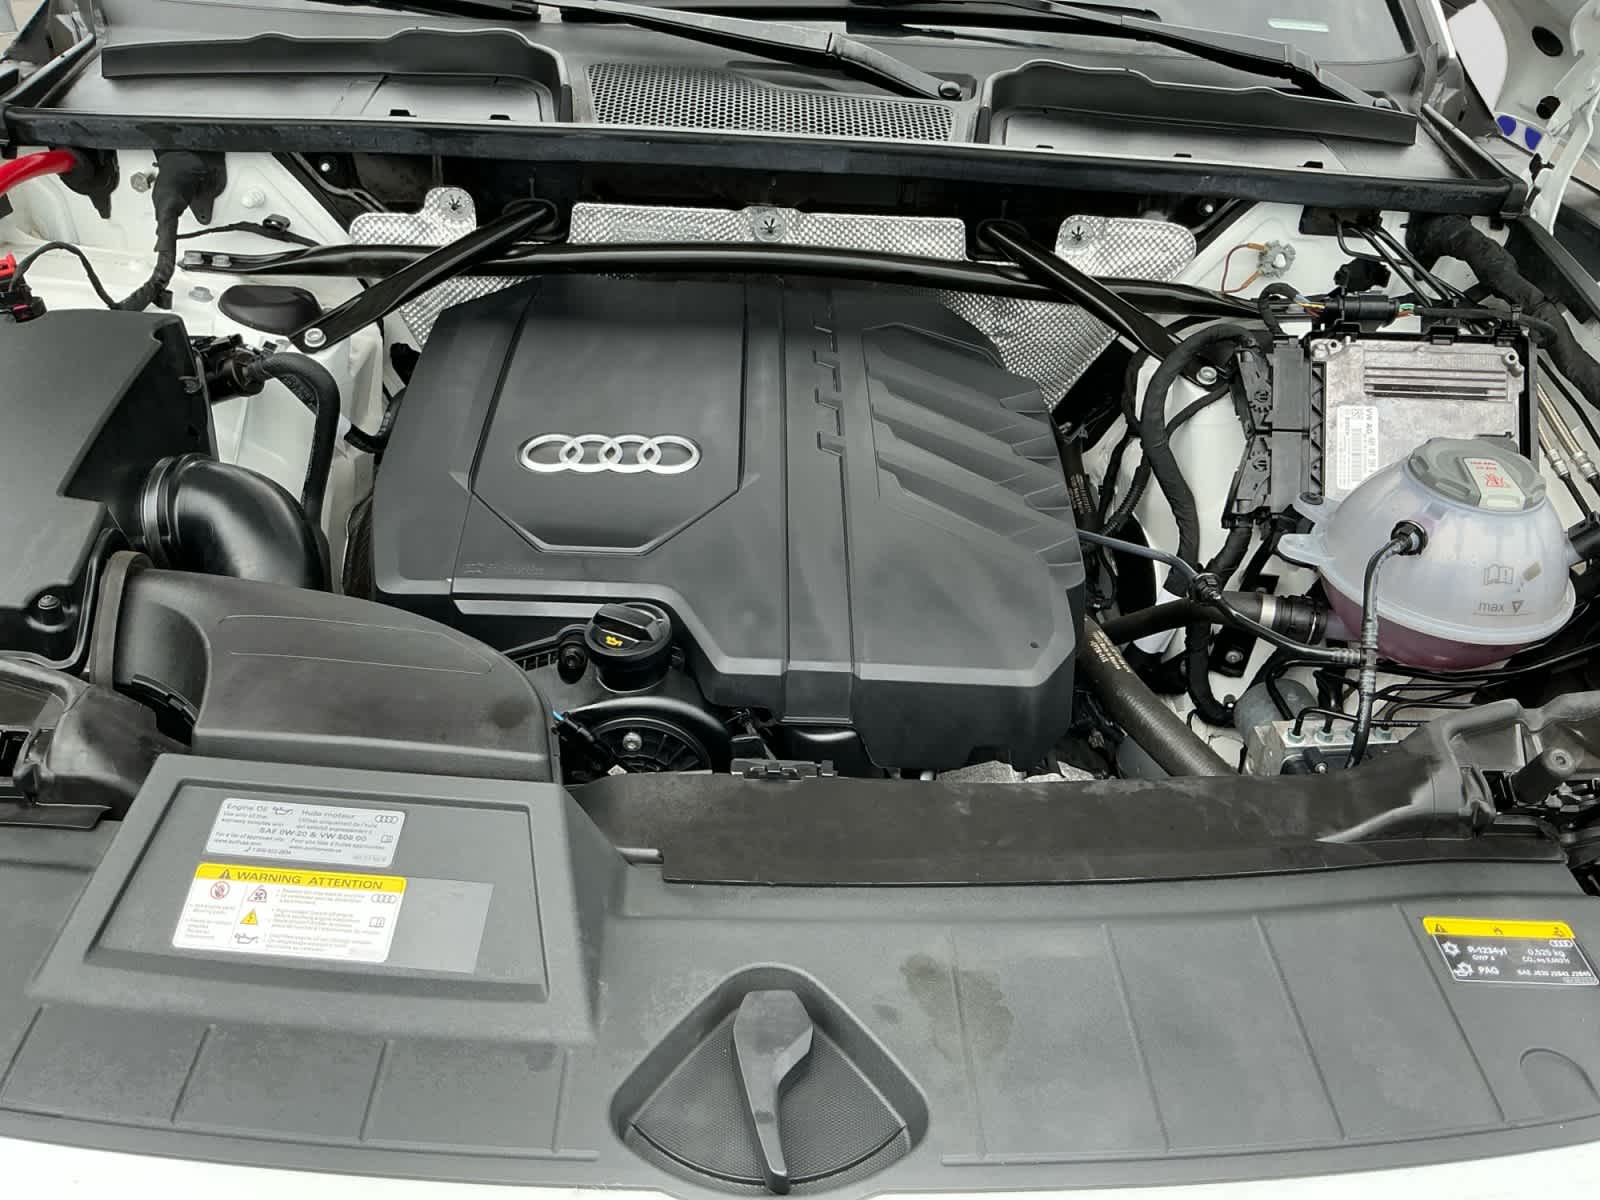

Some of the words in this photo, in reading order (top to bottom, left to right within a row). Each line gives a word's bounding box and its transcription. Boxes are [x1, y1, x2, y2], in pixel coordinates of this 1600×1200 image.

[1480, 602, 1504, 612] max
[226, 803, 254, 812] Engine
[236, 871, 301, 884] WARNING
[308, 876, 384, 889] ATTENTION
